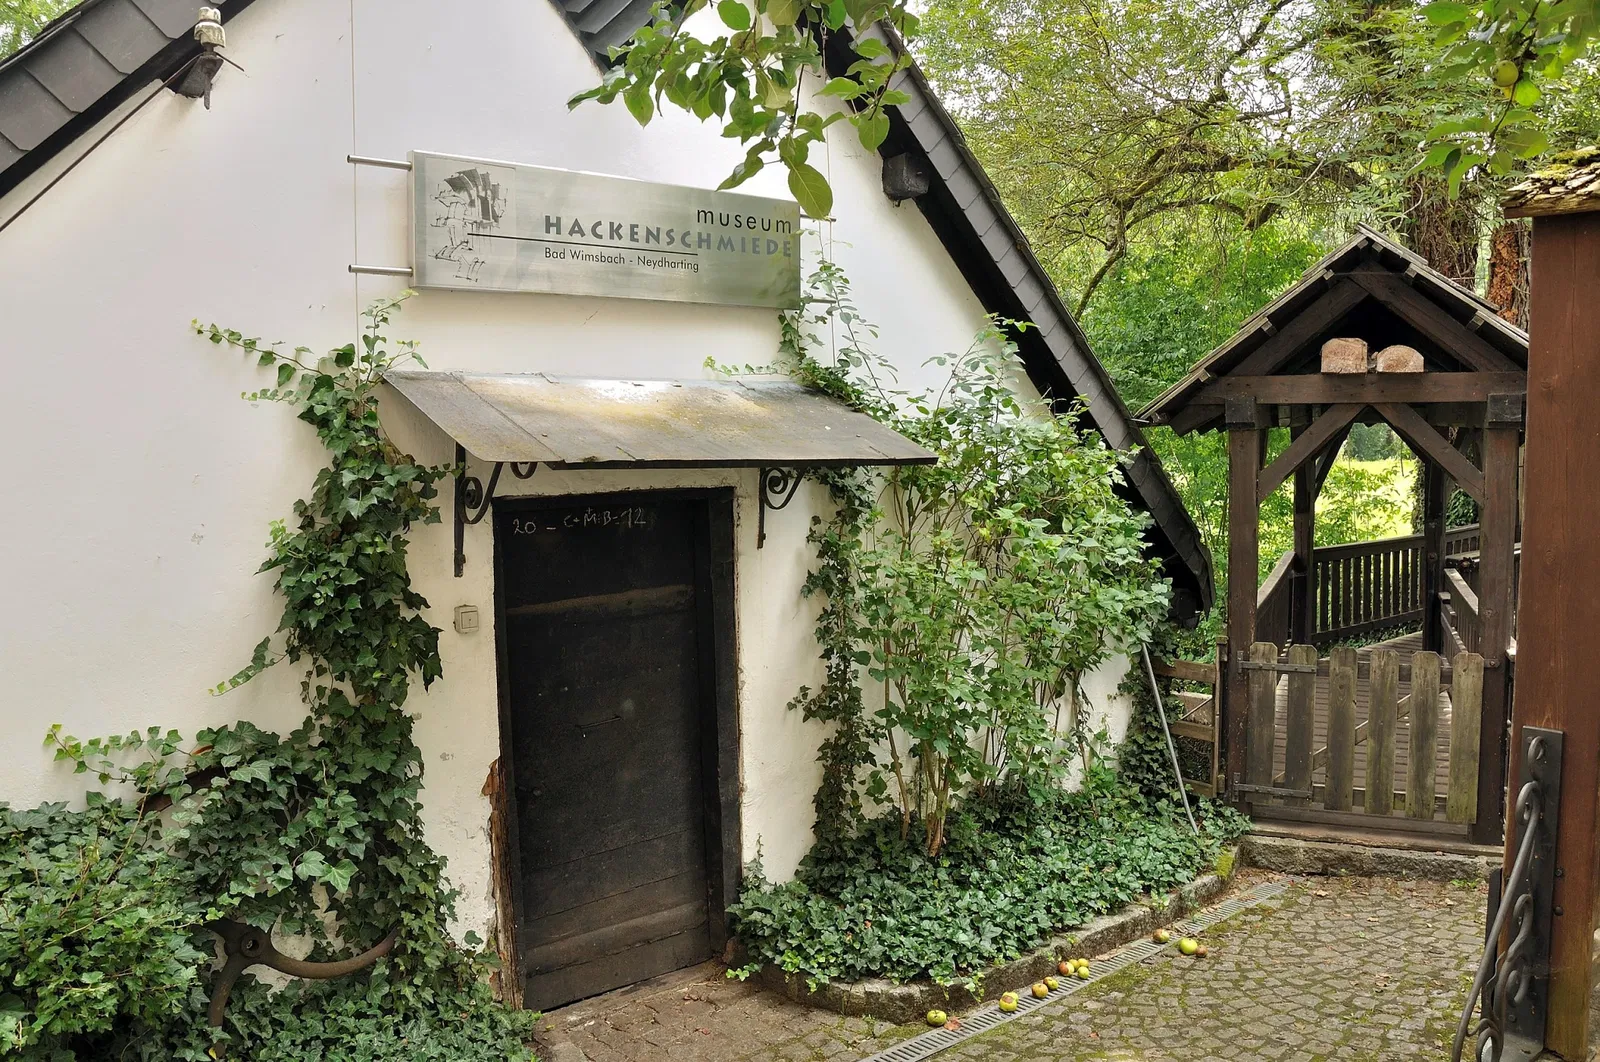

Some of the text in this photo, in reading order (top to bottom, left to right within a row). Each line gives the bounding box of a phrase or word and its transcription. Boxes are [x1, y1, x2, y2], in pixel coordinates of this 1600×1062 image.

[696, 208, 792, 234] museum
[544, 215, 793, 258] HACKENSCHMIEDE
[544, 247, 566, 260] Bad
[570, 249, 626, 265] Wimsbach
[637, 256, 699, 273] Neydharting
